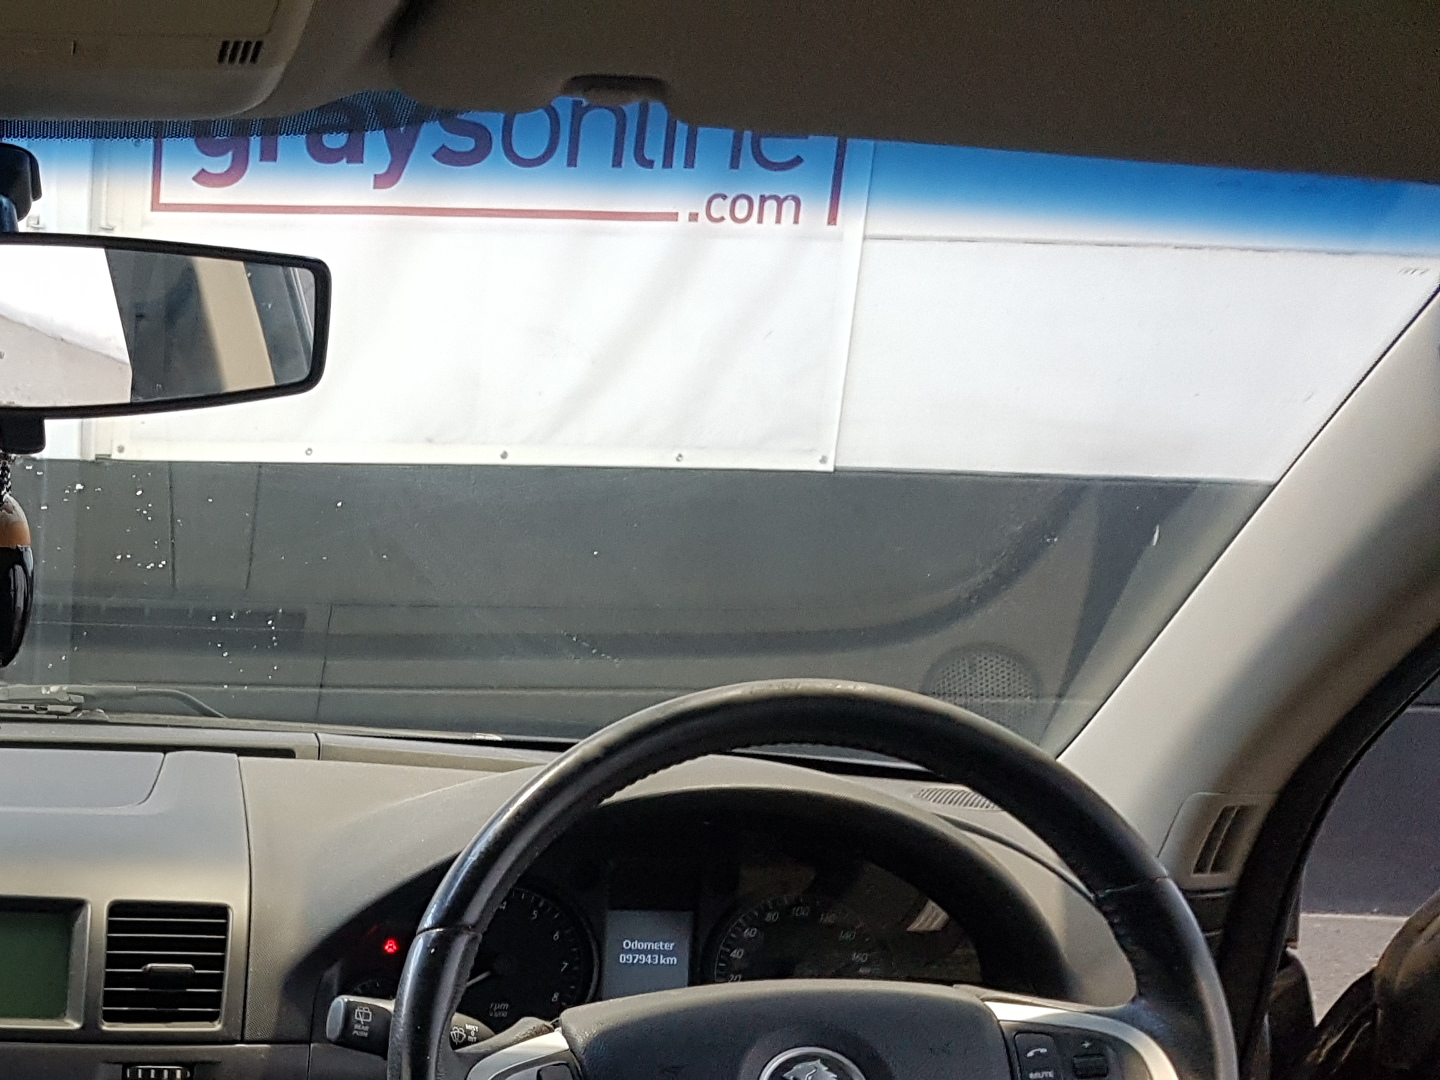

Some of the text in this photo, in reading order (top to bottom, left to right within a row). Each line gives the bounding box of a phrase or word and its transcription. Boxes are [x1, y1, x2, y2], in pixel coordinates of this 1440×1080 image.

[688, 193, 802, 225] .com
[530, 910, 538, 920] 5
[764, 912, 779, 922] 80
[552, 930, 560, 941] 6
[743, 928, 757, 938] 60
[622, 939, 675, 950] Odometer
[619, 953, 678, 965] 097943 km
[729, 948, 744, 959] 40
[560, 962, 569, 972] 7
[551, 992, 559, 1002] 8
[1028, 1069, 1055, 1080] MUTE
